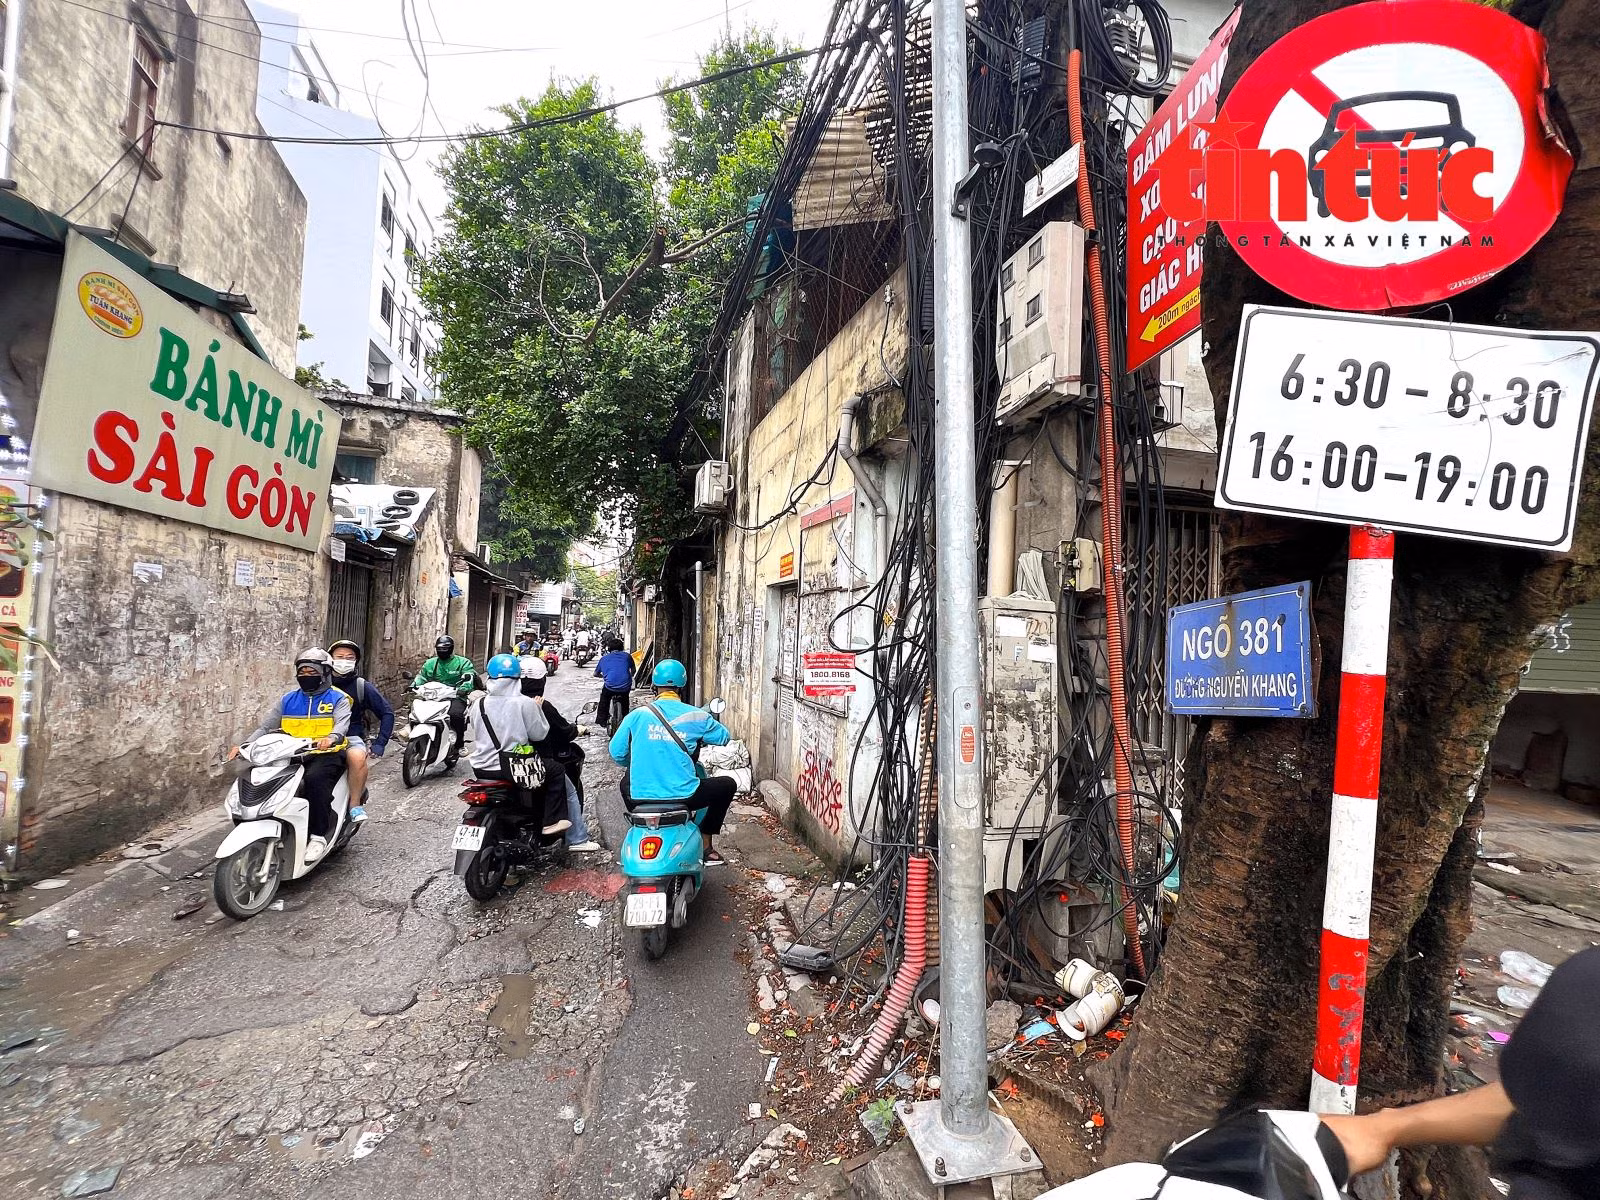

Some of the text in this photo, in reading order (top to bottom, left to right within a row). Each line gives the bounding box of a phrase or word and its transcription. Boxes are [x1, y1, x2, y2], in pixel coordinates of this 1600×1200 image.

[1140, 258, 1181, 314] GIÁC
[110, 306, 133, 325] KHANG
[1158, 307, 1179, 329] 200m
[149, 326, 324, 470] BÁNH MÌ
[1281, 353, 1391, 409] 6:30
[1447, 370, 1562, 429] 8:30
[87, 410, 316, 537] SÀI GÒN
[1183, 614, 1283, 661] NGÕ 381
[1207, 668, 1249, 698] NGUYỄN
[1251, 672, 1297, 697] KHANG
[317, 700, 334, 714] be
